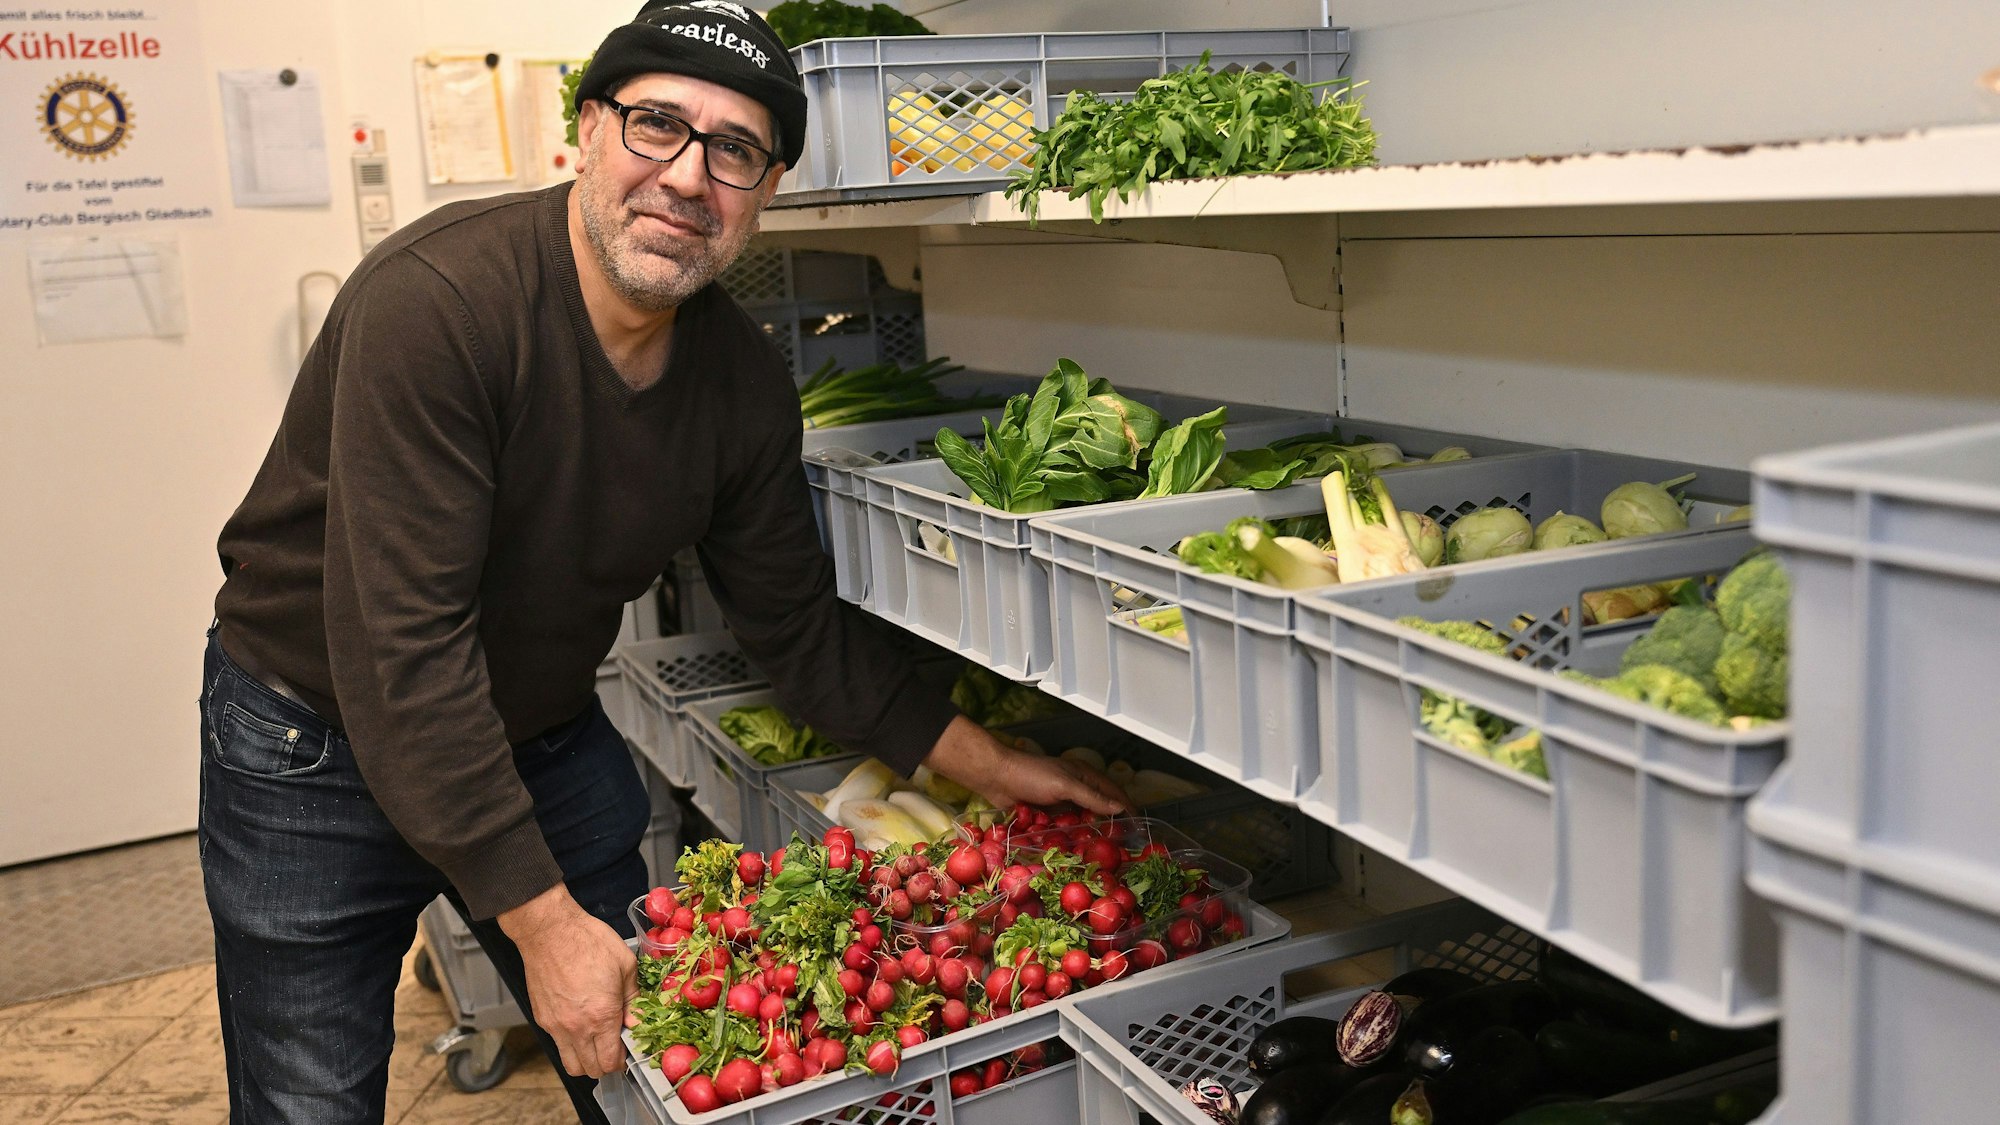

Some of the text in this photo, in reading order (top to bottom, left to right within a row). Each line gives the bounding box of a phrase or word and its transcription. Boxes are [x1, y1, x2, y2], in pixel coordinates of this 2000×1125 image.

[31, 10, 62, 21] alles
[65, 9, 104, 20] frisch
[0, 31, 160, 60] Kühlzelle
[661, 22, 770, 69] earless
[26, 176, 164, 193] Für die Tafel gestiftet
[84, 196, 113, 206] vom
[77, 209, 142, 225] Bergisch
[145, 207, 213, 220] Gladbach
